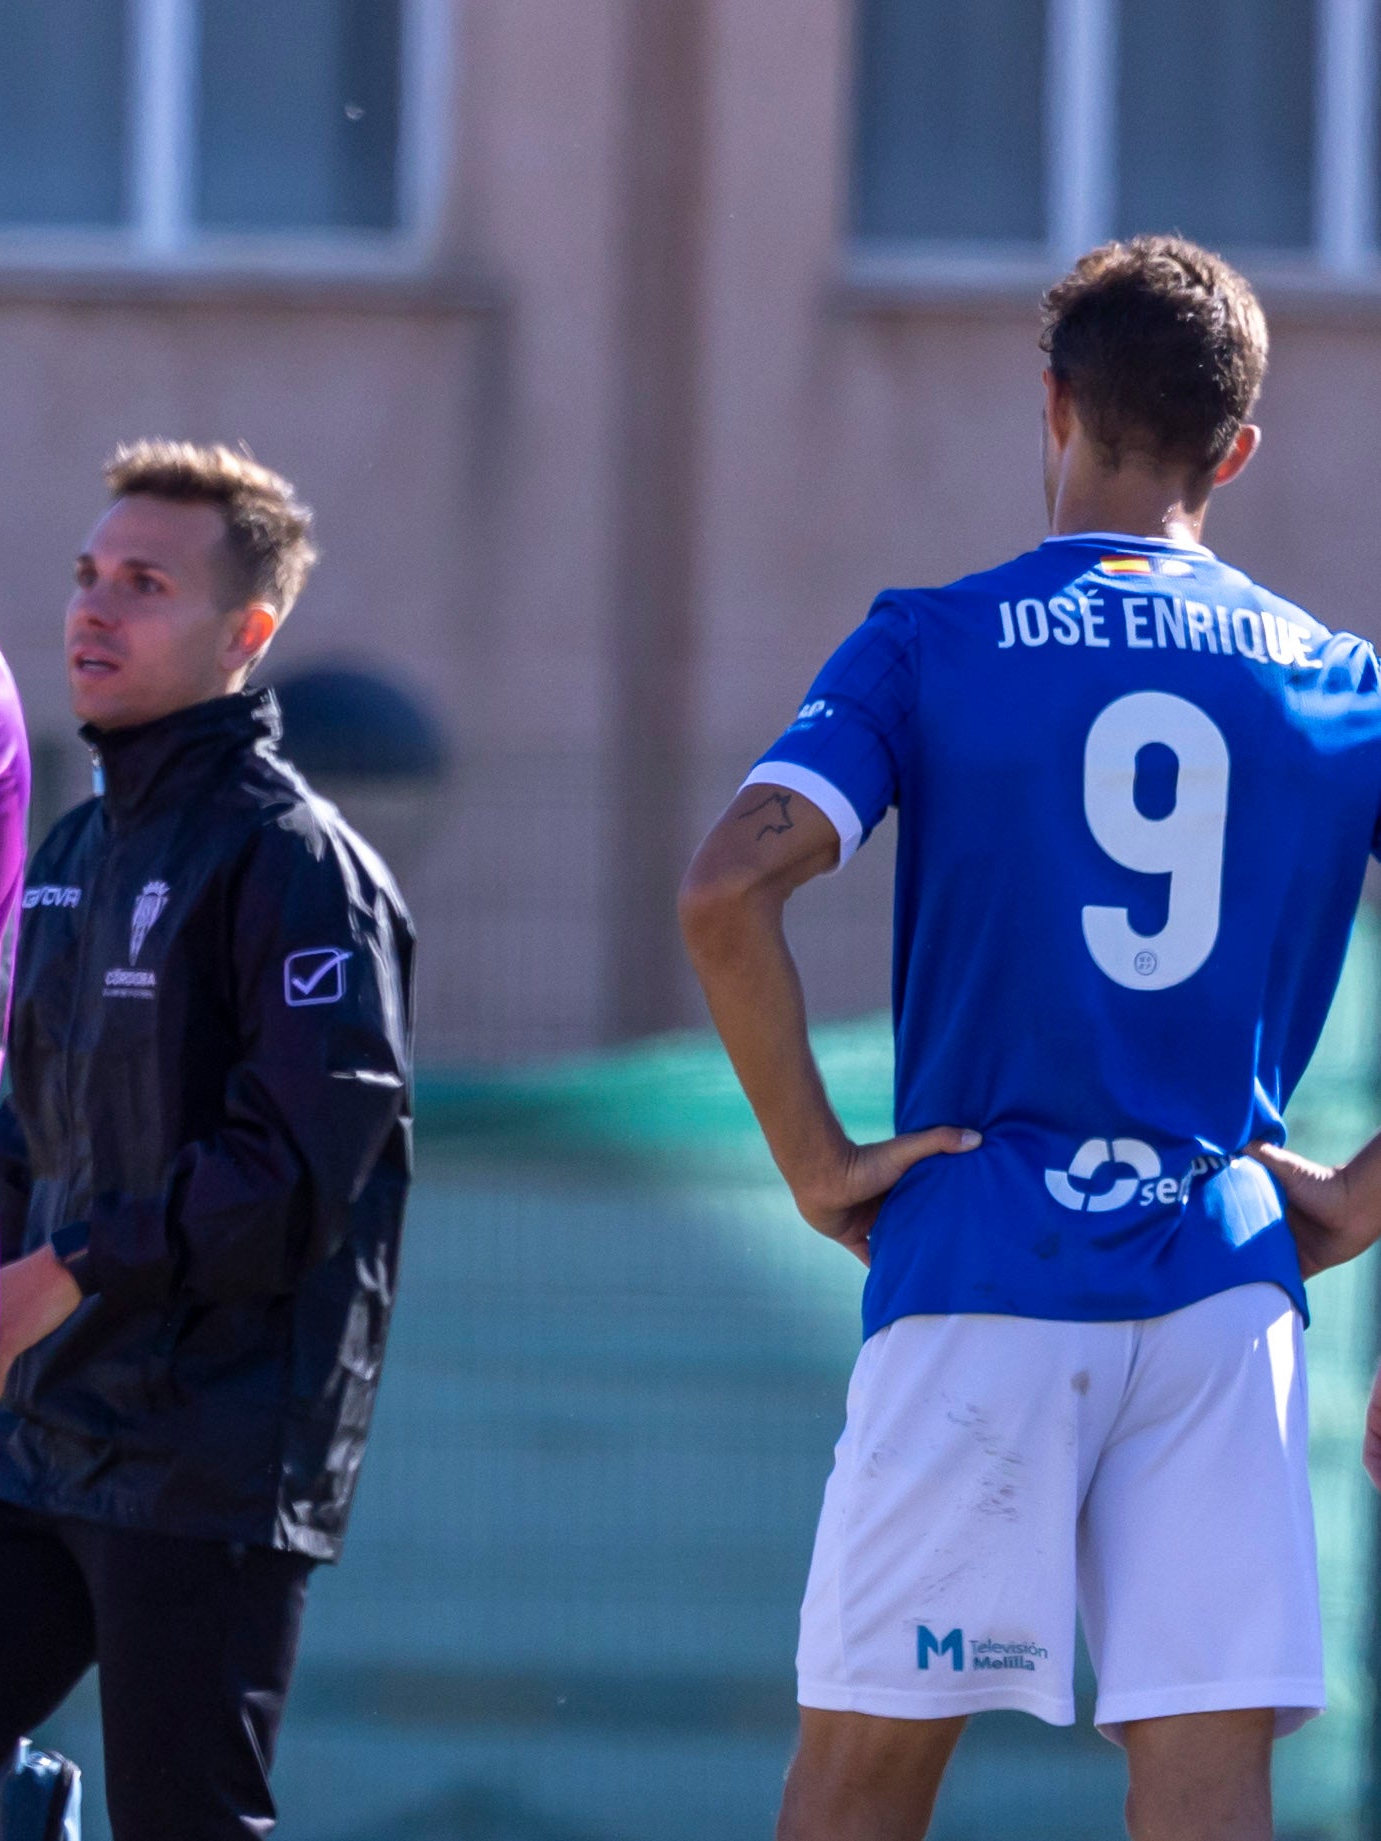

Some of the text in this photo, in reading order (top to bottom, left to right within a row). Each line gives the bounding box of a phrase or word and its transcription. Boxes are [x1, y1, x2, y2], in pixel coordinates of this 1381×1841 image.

[997, 588, 1323, 669] JOSÉ ENRIQUE
[1082, 690, 1230, 991] 9
[968, 1638, 1049, 1659] Televisión
[973, 1655, 1036, 1672] Melilla
